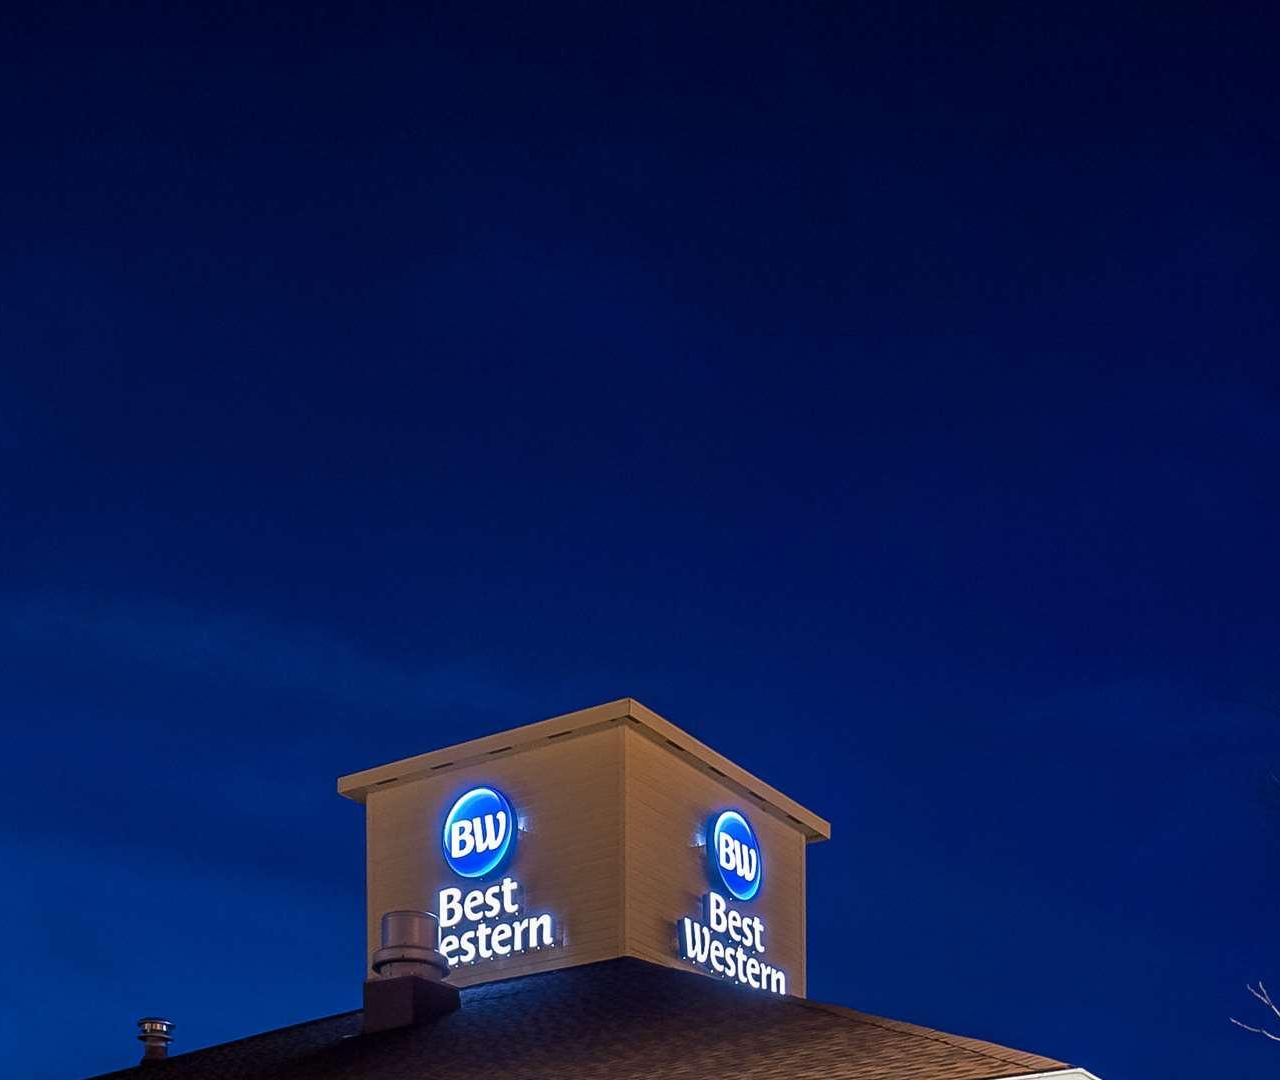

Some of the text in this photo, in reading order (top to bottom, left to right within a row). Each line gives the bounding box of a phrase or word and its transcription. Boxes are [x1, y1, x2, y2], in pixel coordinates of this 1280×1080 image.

[451, 811, 507, 859] BW
[719, 831, 757, 882] BW
[439, 877, 519, 927] Best
[709, 891, 765, 953] Best
[440, 913, 554, 966] estern
[684, 917, 786, 996] Western
